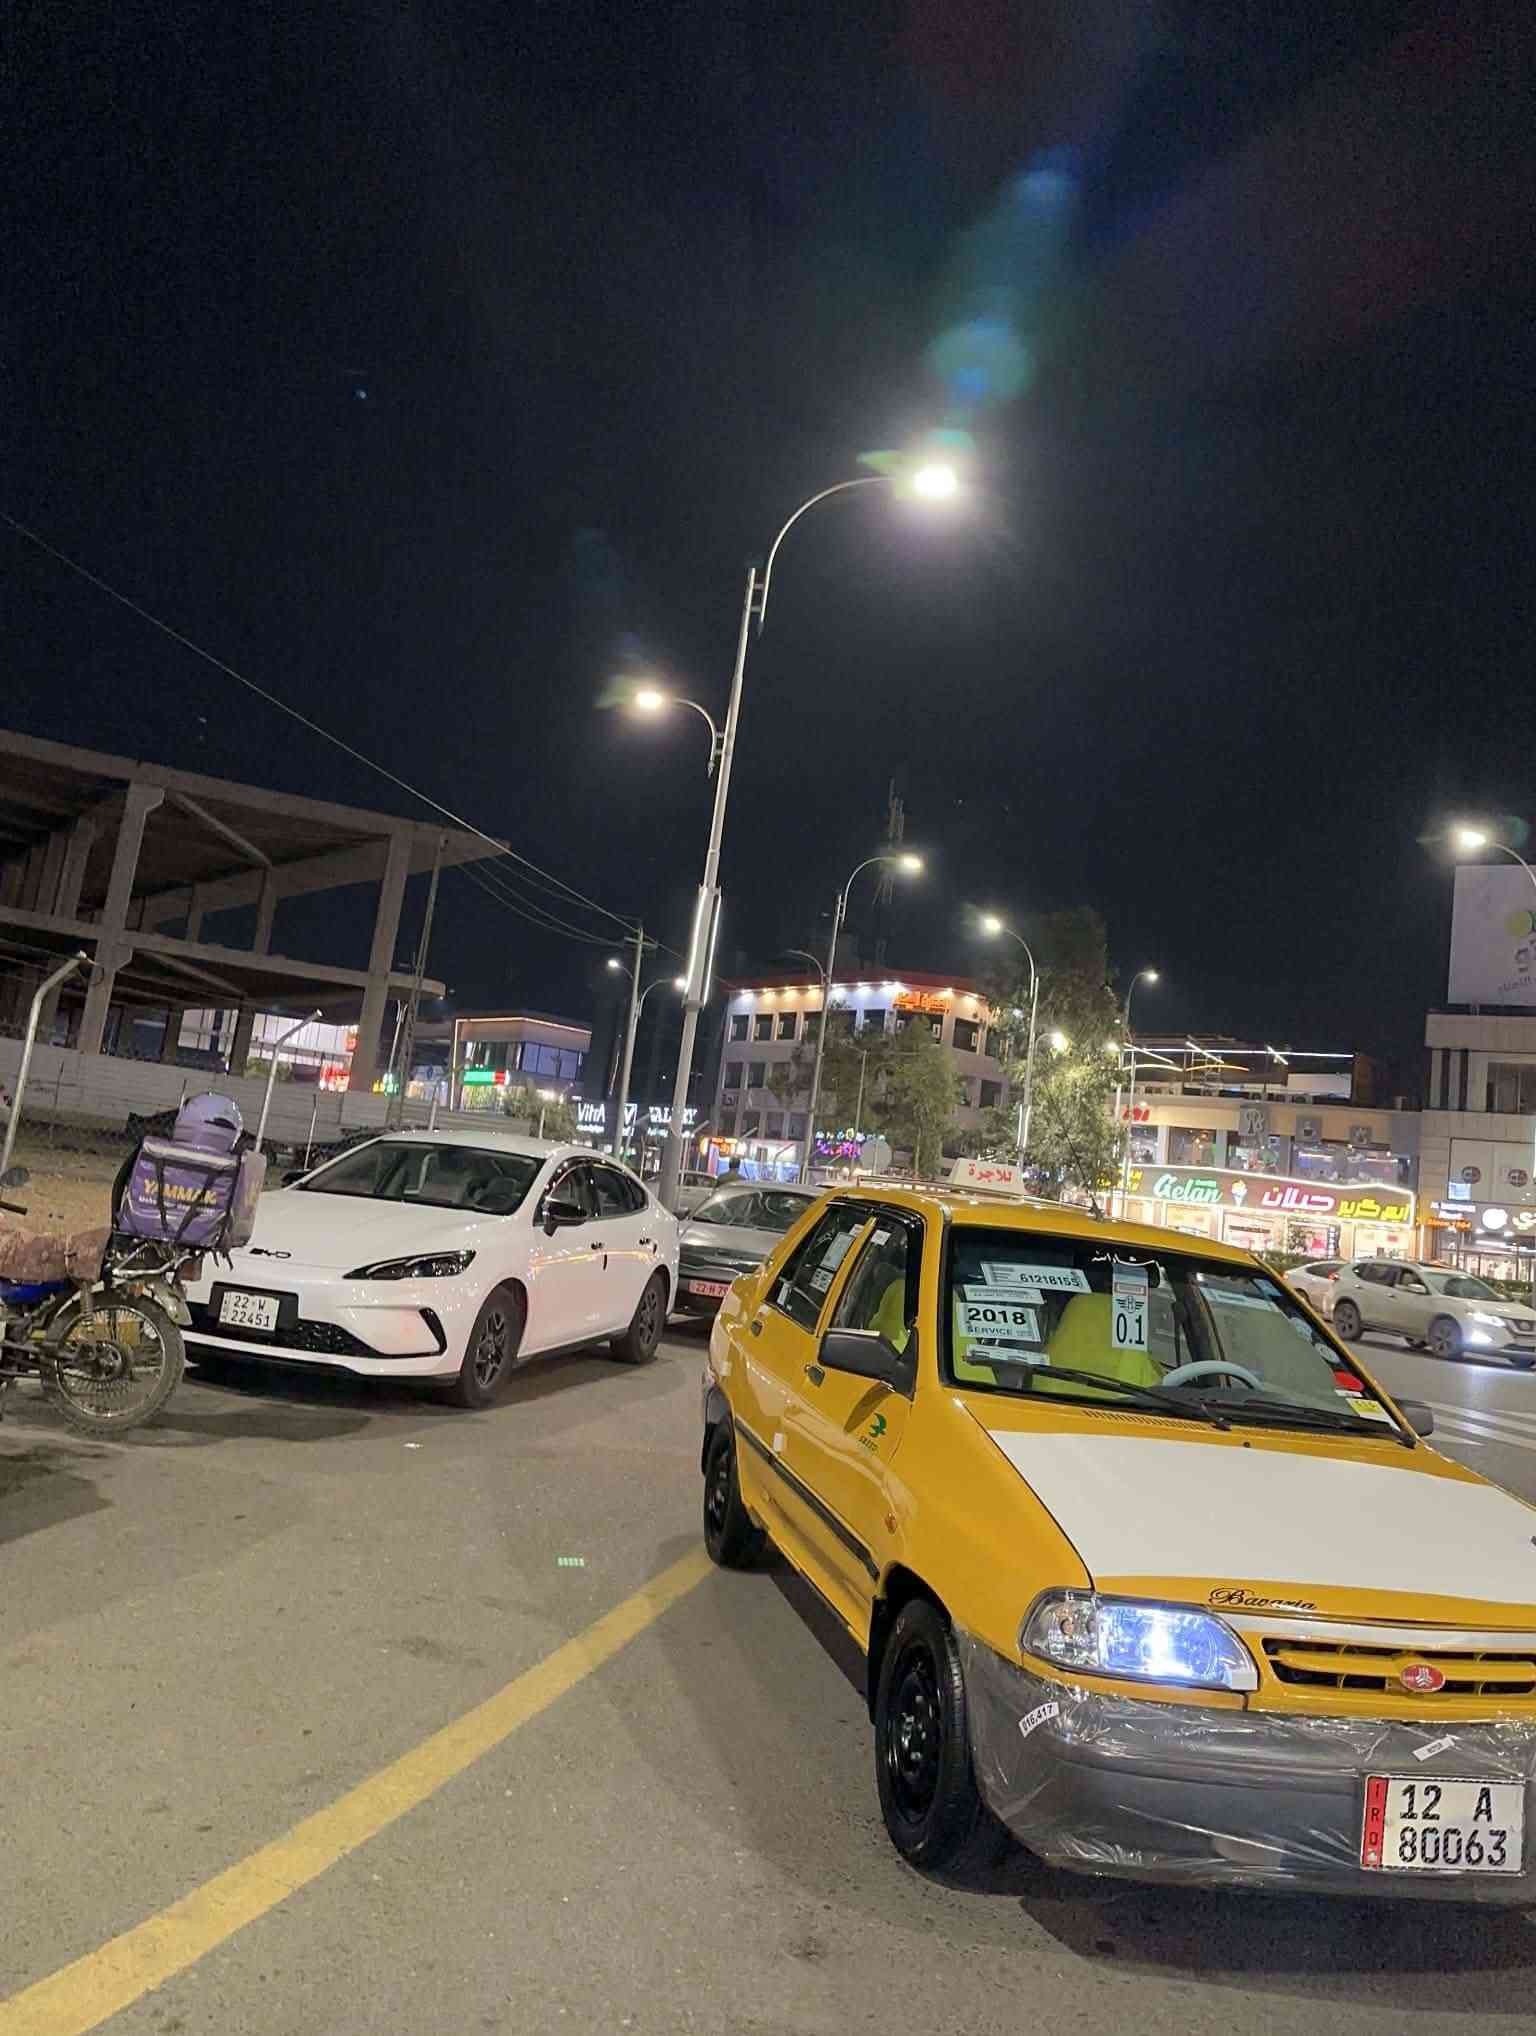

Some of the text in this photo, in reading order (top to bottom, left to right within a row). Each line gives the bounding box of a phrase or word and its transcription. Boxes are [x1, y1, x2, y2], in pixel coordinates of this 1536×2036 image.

[1153, 1172, 1223, 1203] Gelan
[233, 1295, 249, 1309] 22
[230, 1308, 270, 1328] 22451
[967, 1307, 1027, 1326] 2018
[1116, 1313, 1145, 1345] 0.1
[1208, 1587, 1318, 1610] Bavaria
[1399, 1783, 1494, 1823] 12 A
[1398, 1825, 1508, 1867] 80063
